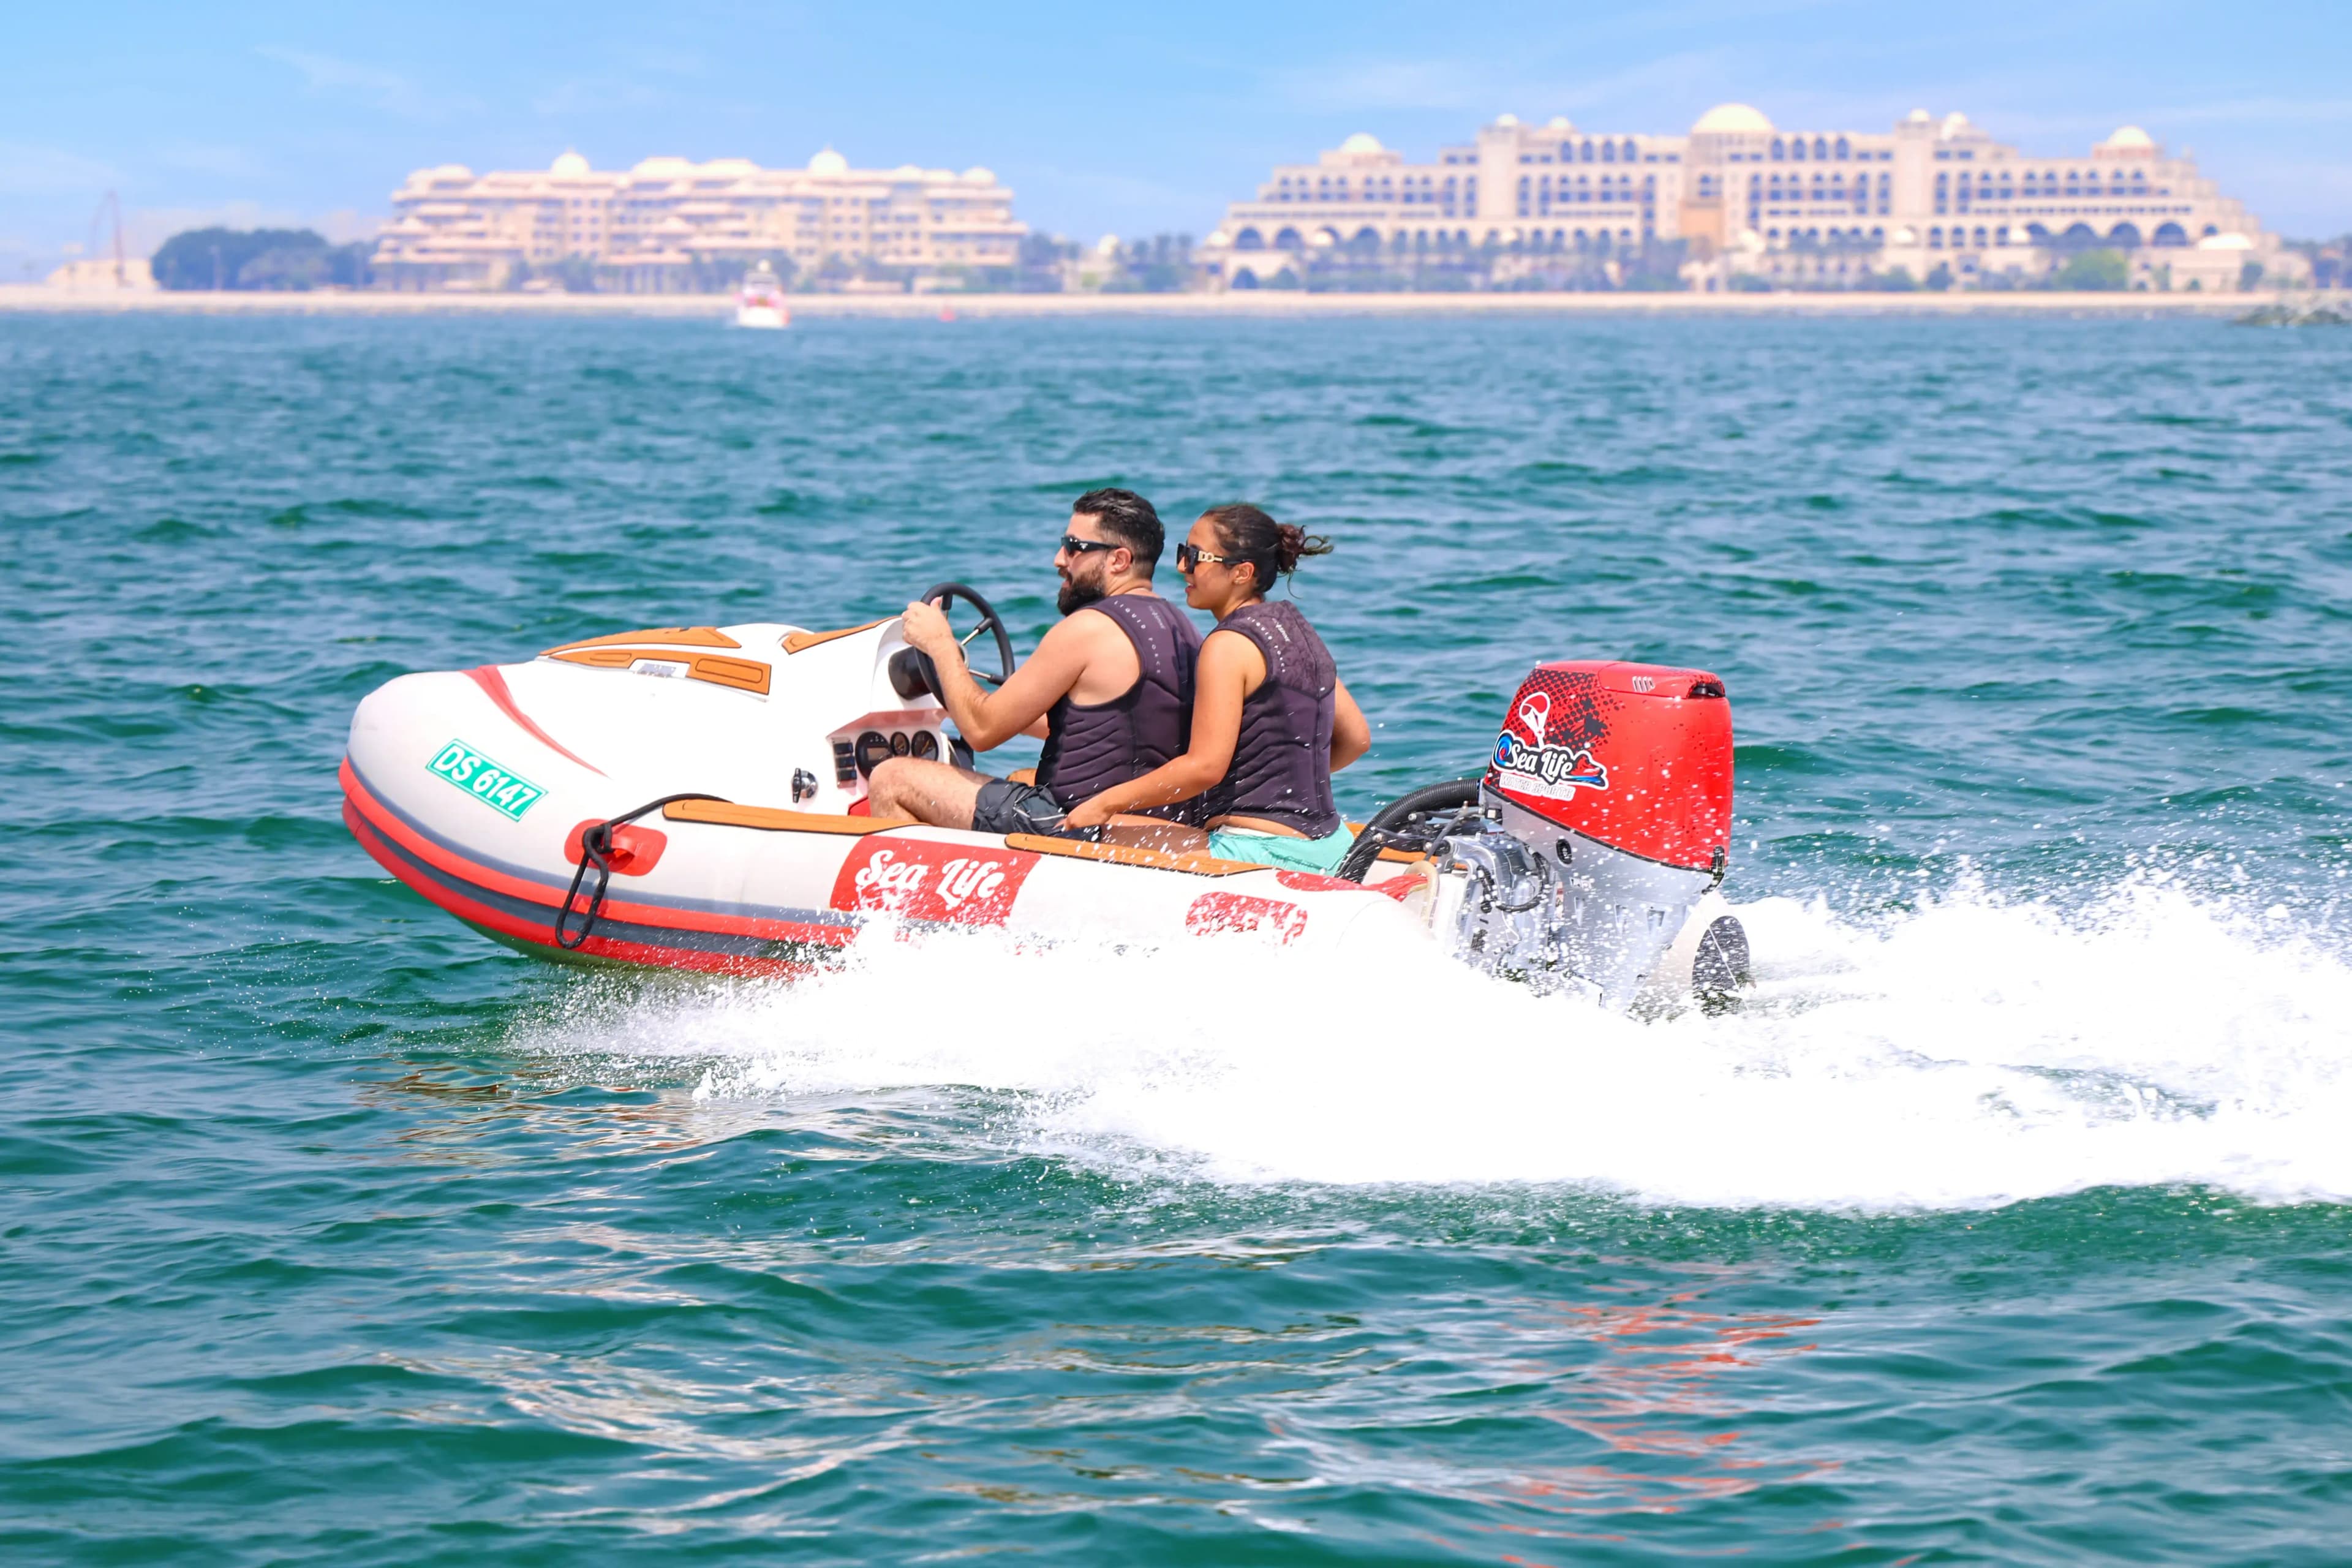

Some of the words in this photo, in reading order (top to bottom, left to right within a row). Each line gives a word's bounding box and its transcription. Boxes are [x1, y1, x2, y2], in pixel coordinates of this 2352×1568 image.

[432, 745, 482, 782] DS
[472, 769, 538, 812] 6147
[1504, 742, 1538, 772] Sea
[1540, 750, 1574, 783] Life
[854, 850, 929, 891] Sea
[935, 858, 1005, 908] Life
